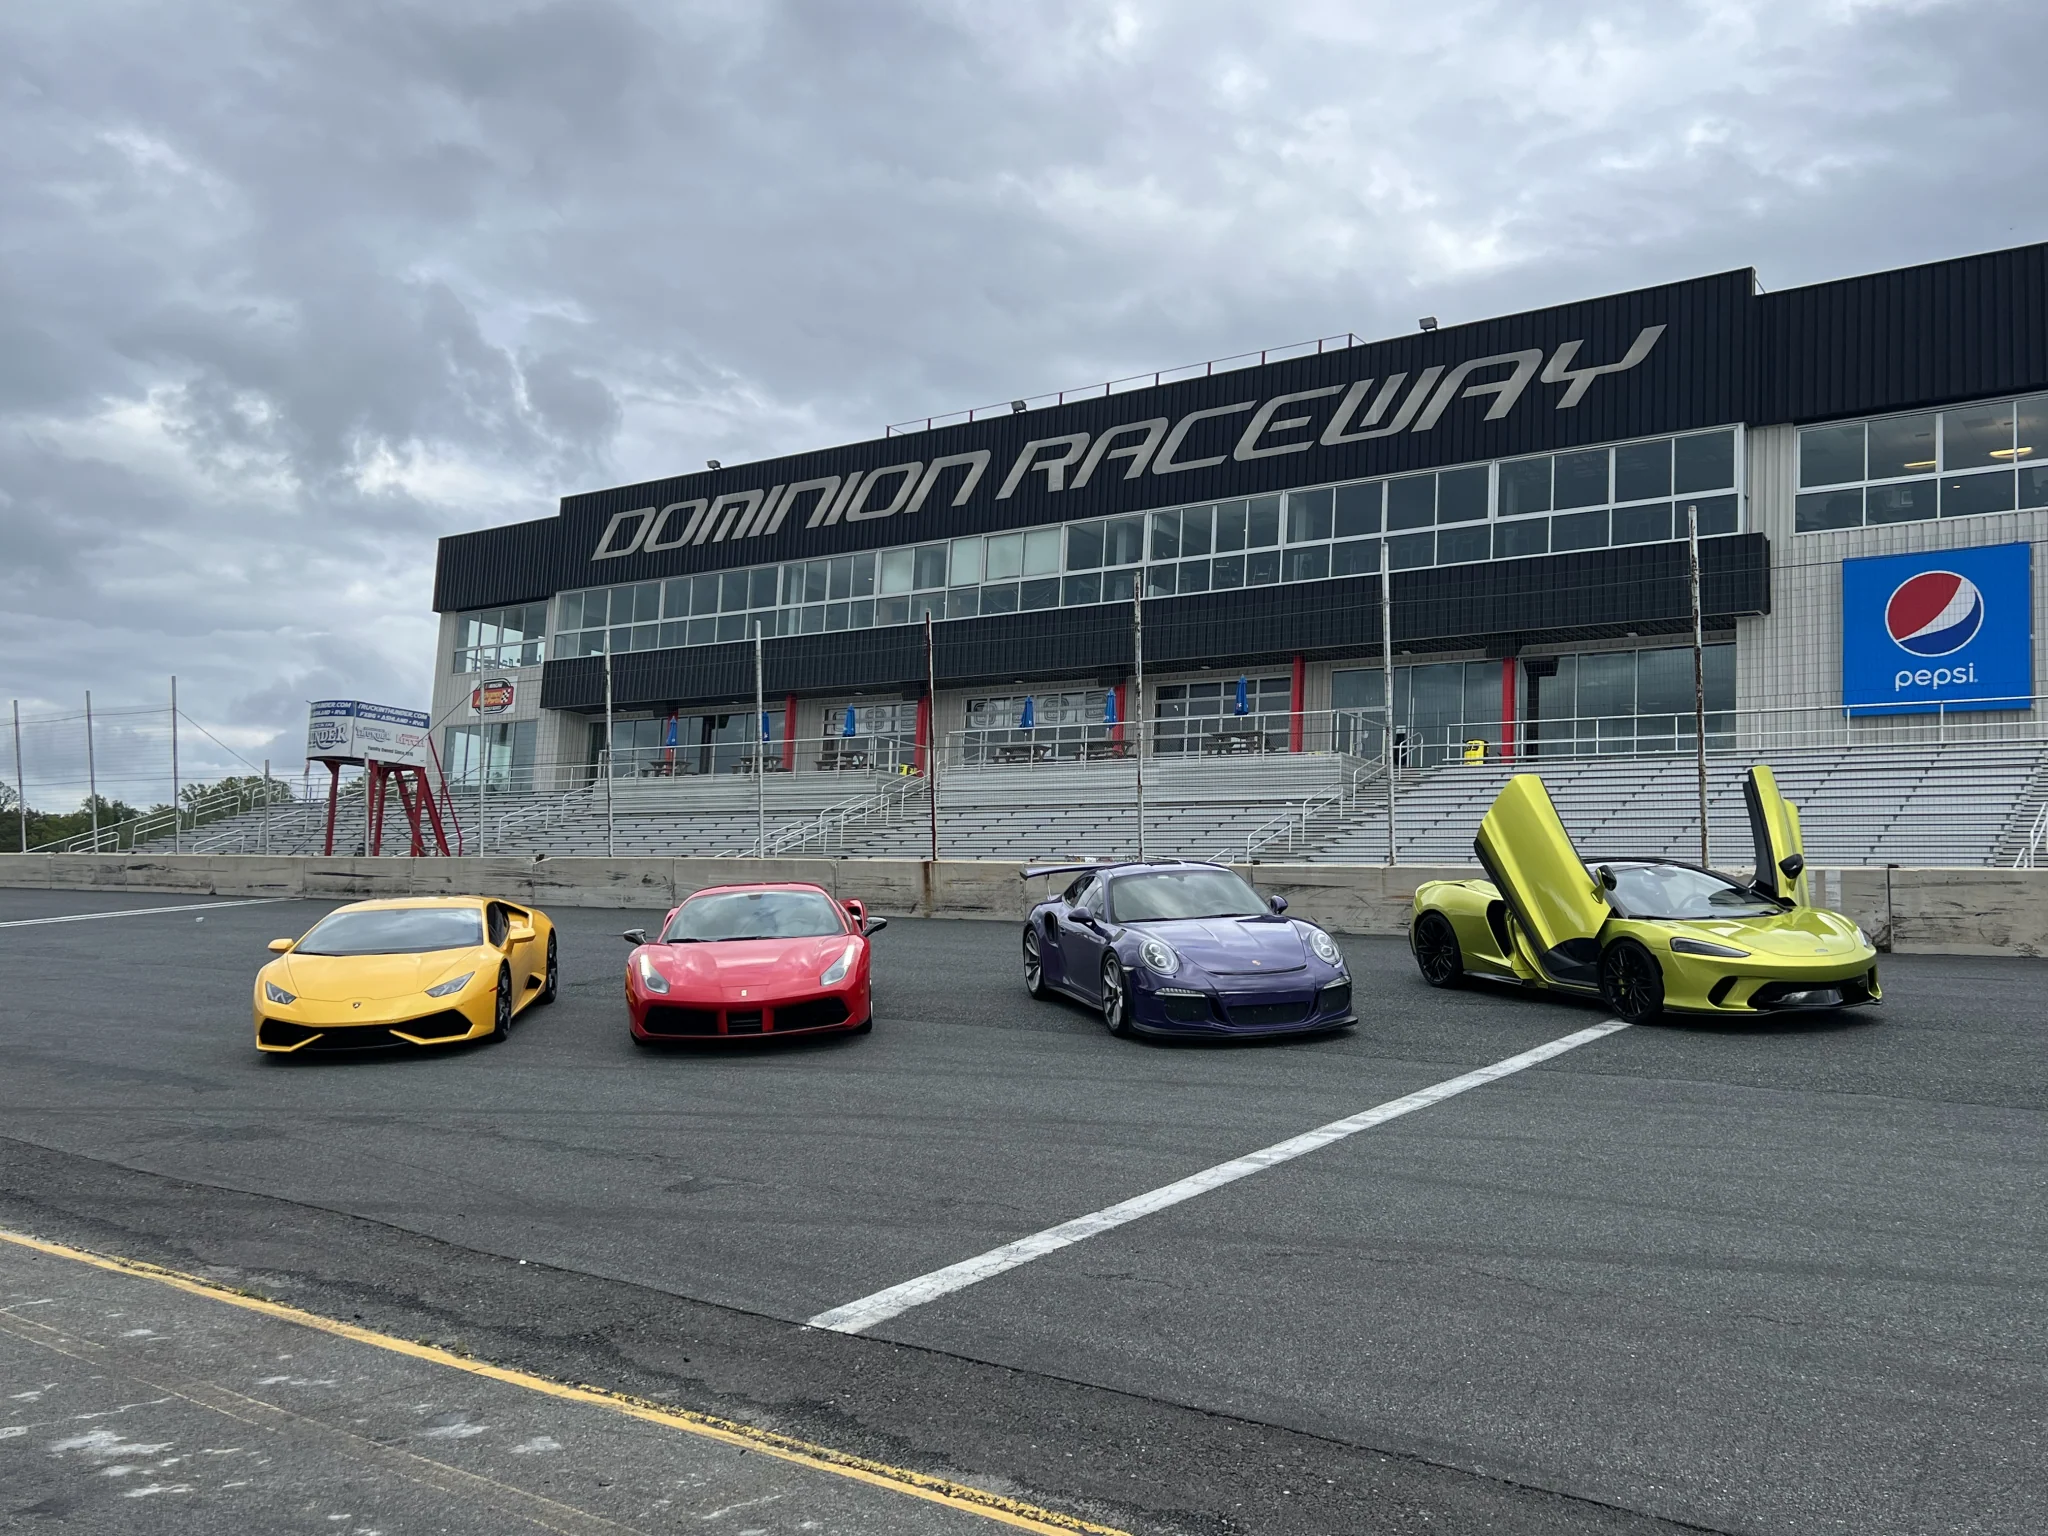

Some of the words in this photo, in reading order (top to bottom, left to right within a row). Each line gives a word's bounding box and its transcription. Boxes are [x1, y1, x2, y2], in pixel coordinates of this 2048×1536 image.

[591, 449, 991, 561] DOMINION
[995, 324, 1667, 500] RACEWAY
[1894, 662, 1975, 692] pepsi
